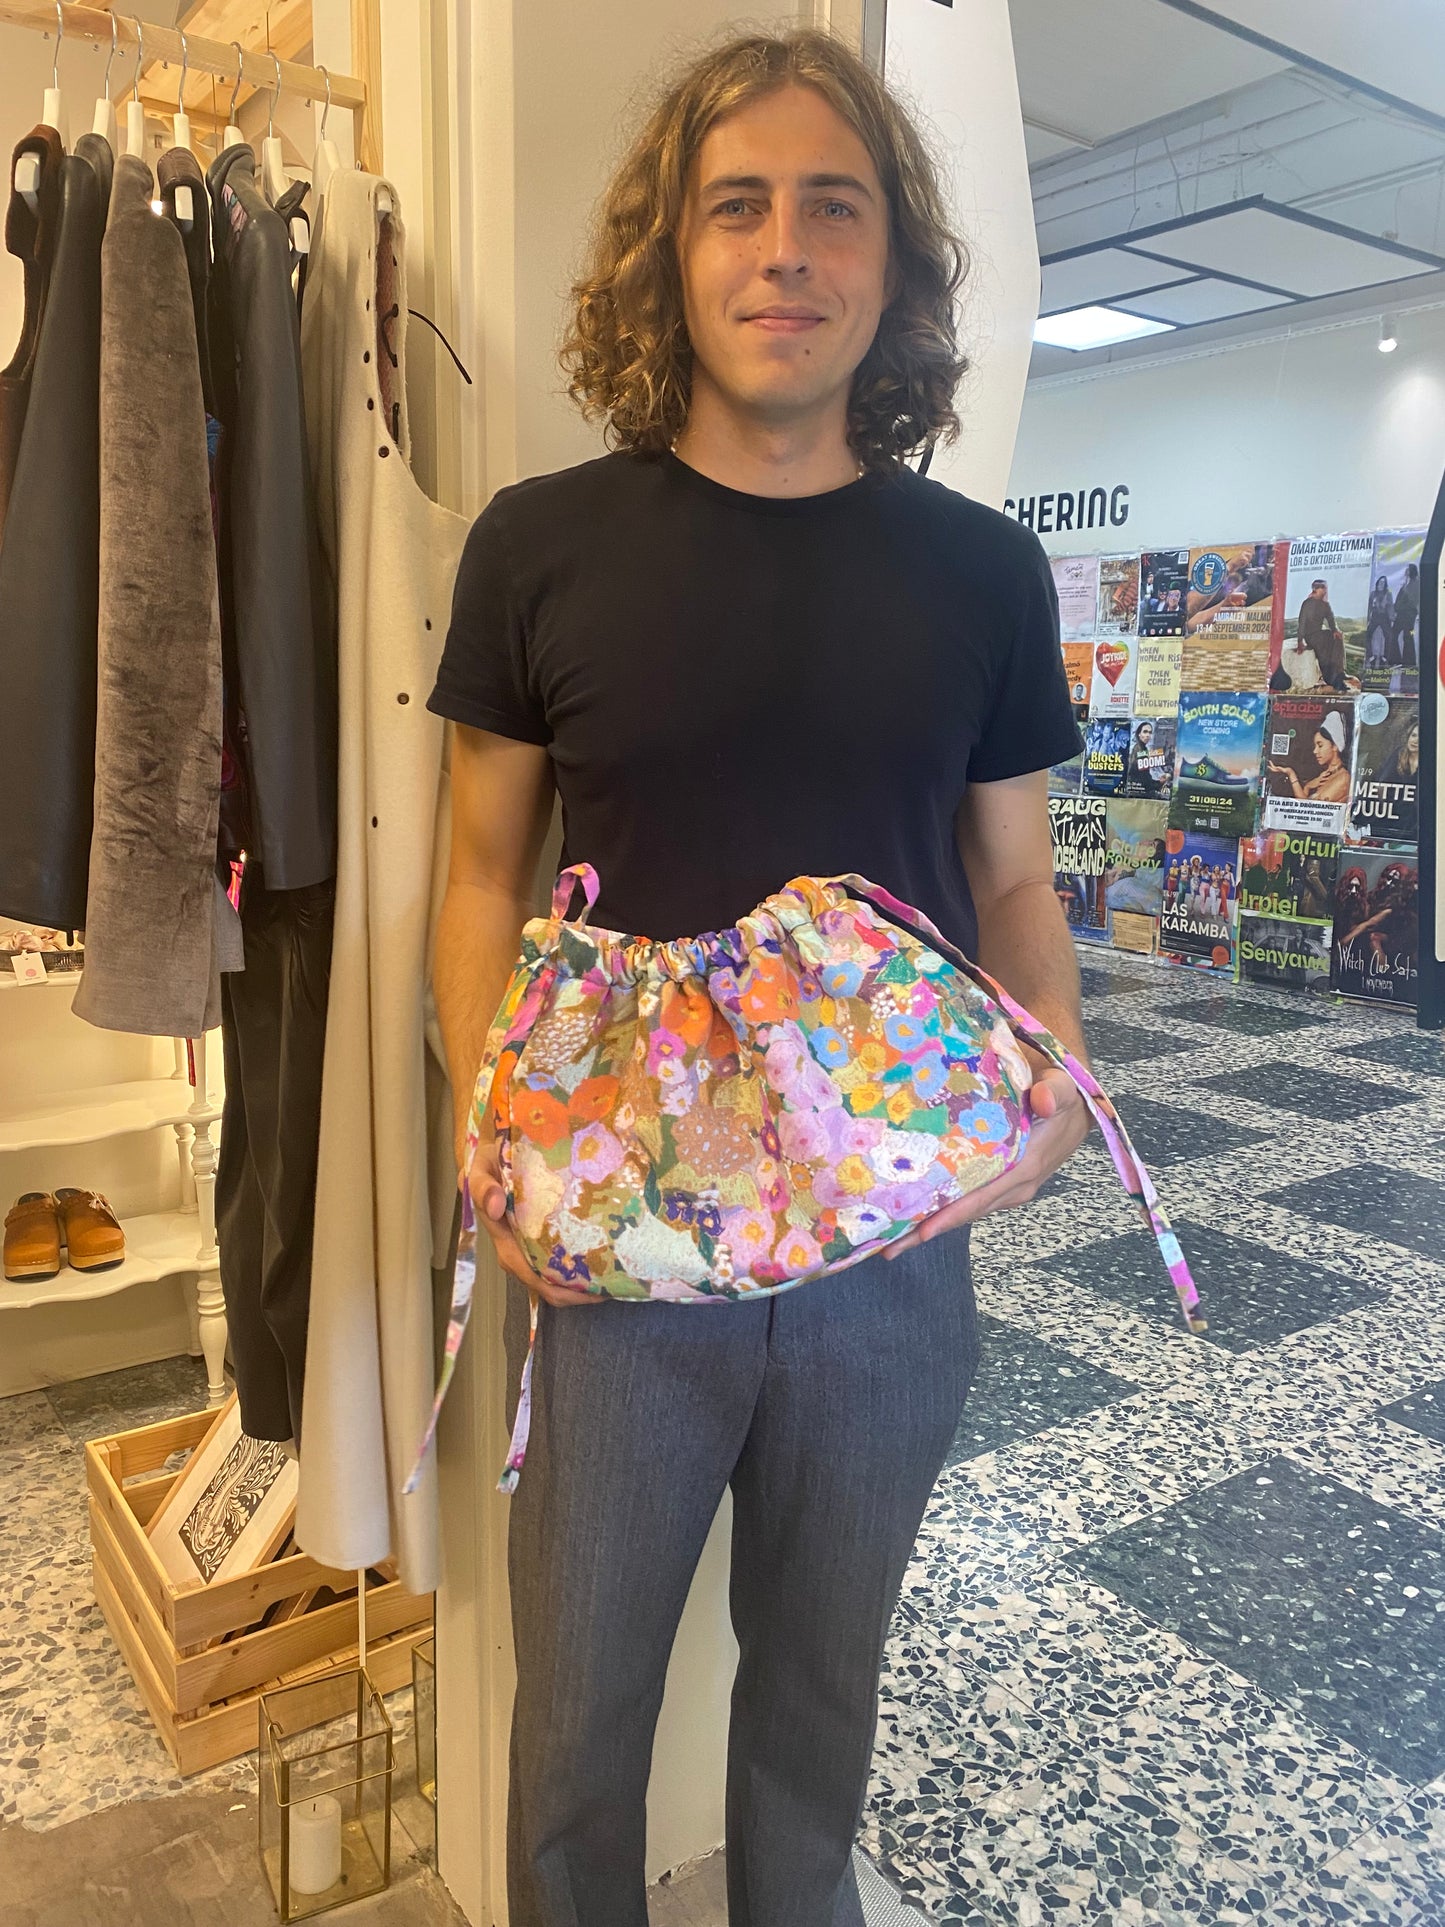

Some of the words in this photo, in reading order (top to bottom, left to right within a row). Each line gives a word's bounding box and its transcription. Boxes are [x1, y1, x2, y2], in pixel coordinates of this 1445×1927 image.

[1290, 542, 1317, 556] OMAR
[1318, 537, 1373, 553] SOULEYMAN
[1303, 556, 1309, 566] 5
[1310, 554, 1343, 565] OKTOBER
[1212, 612, 1246, 622] AMIRALEN
[1213, 623, 1251, 633] SEPTEMBER
[1251, 623, 1270, 633] 2024
[1149, 670, 1170, 678] THEN
[1147, 678, 1172, 686] COMES
[1183, 703, 1220, 723] SOUTH
[1220, 703, 1256, 726] SOLES
[1197, 719, 1214, 727] NEW
[1214, 719, 1239, 728] STORE
[1202, 726, 1231, 735] COMING
[1091, 751, 1122, 763] Block
[1137, 755, 1166, 770] BOOM!
[1088, 760, 1124, 771] busters
[1357, 767, 1373, 776] 12/9
[1354, 781, 1417, 802] METTE
[1352, 800, 1400, 820] JUUL
[1105, 849, 1161, 873] Rousay
[1162, 900, 1188, 917] LAS
[1161, 916, 1230, 940] KARAMBA
[1337, 936, 1365, 973] Witch
[1369, 949, 1390, 976] Club
